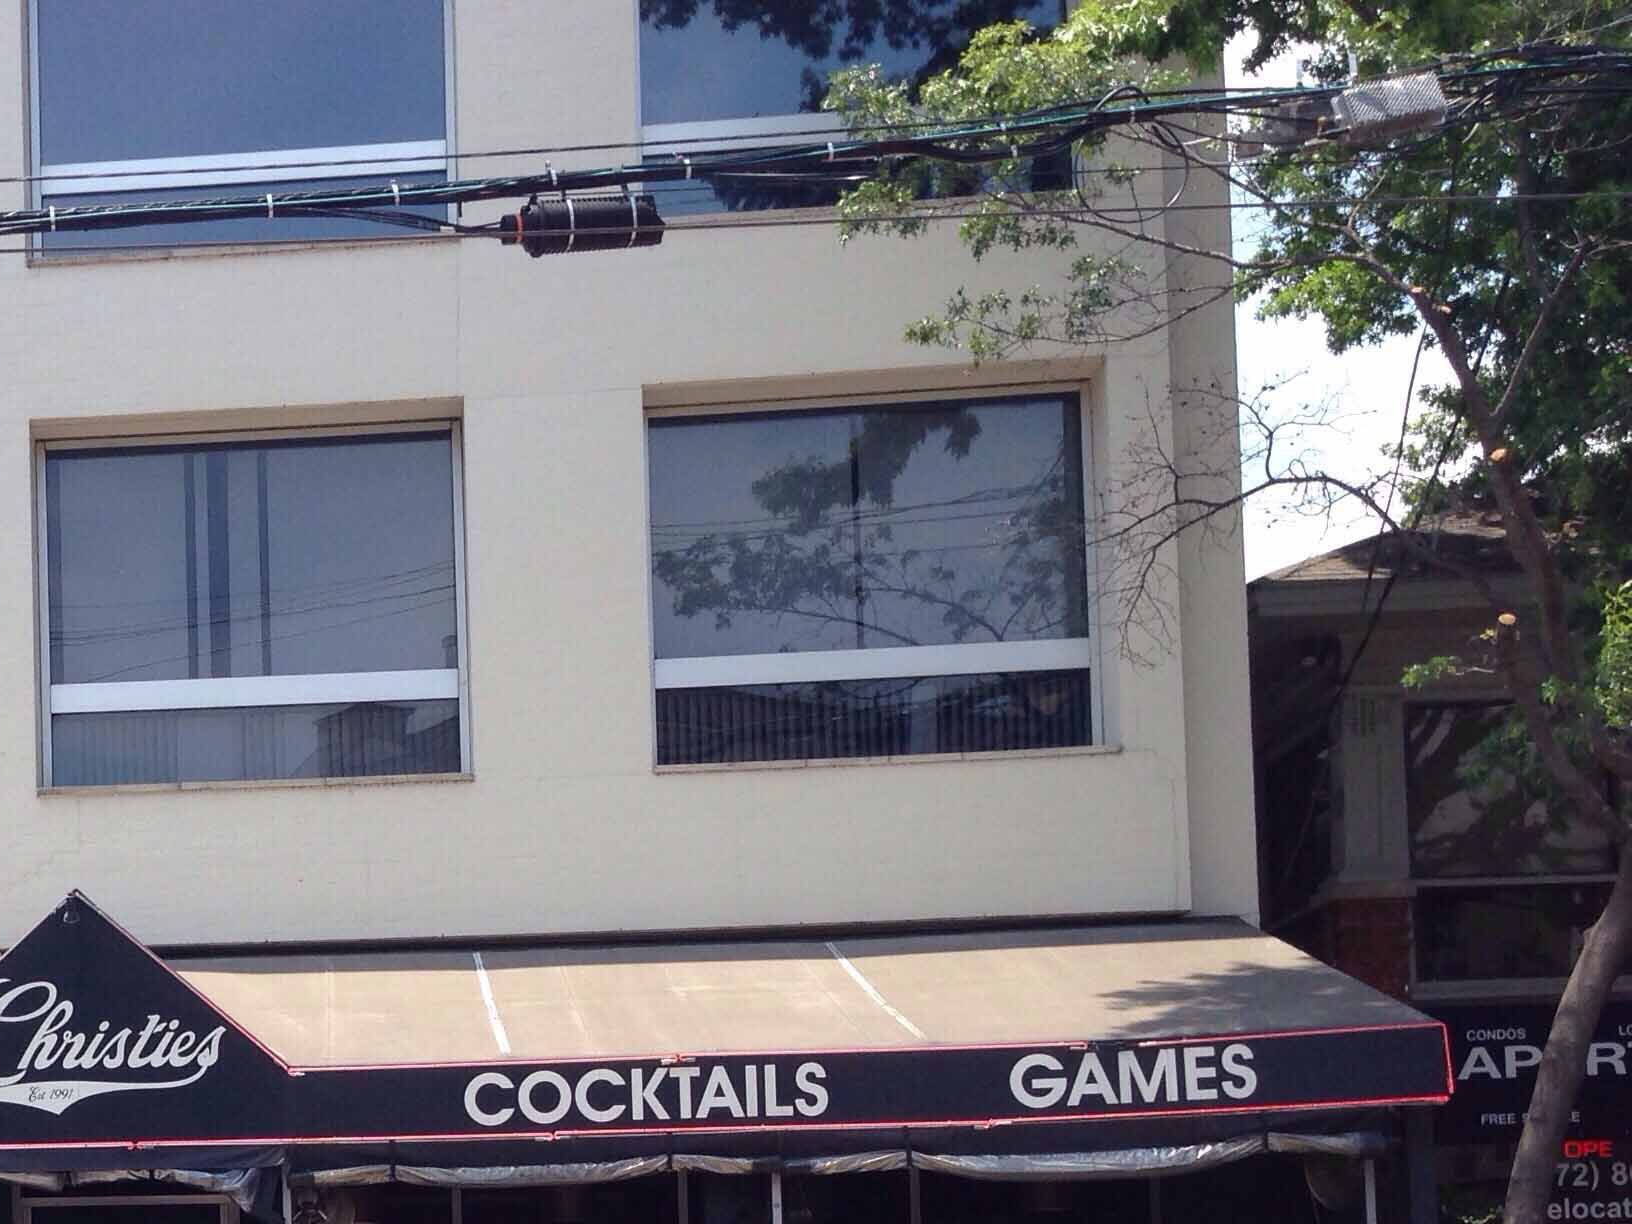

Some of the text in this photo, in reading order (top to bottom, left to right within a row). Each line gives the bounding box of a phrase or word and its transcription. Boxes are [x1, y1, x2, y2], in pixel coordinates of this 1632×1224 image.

[1466, 1028, 1527, 1041] CONDOS
[1458, 1041, 1632, 1080] APR
[1009, 1043, 1258, 1109] GAMES
[49, 1086, 74, 1101] 1991
[463, 1062, 830, 1128] COCKTAILS
[1480, 1112, 1517, 1126] FREE
[1556, 1161, 1600, 1191] 72)
